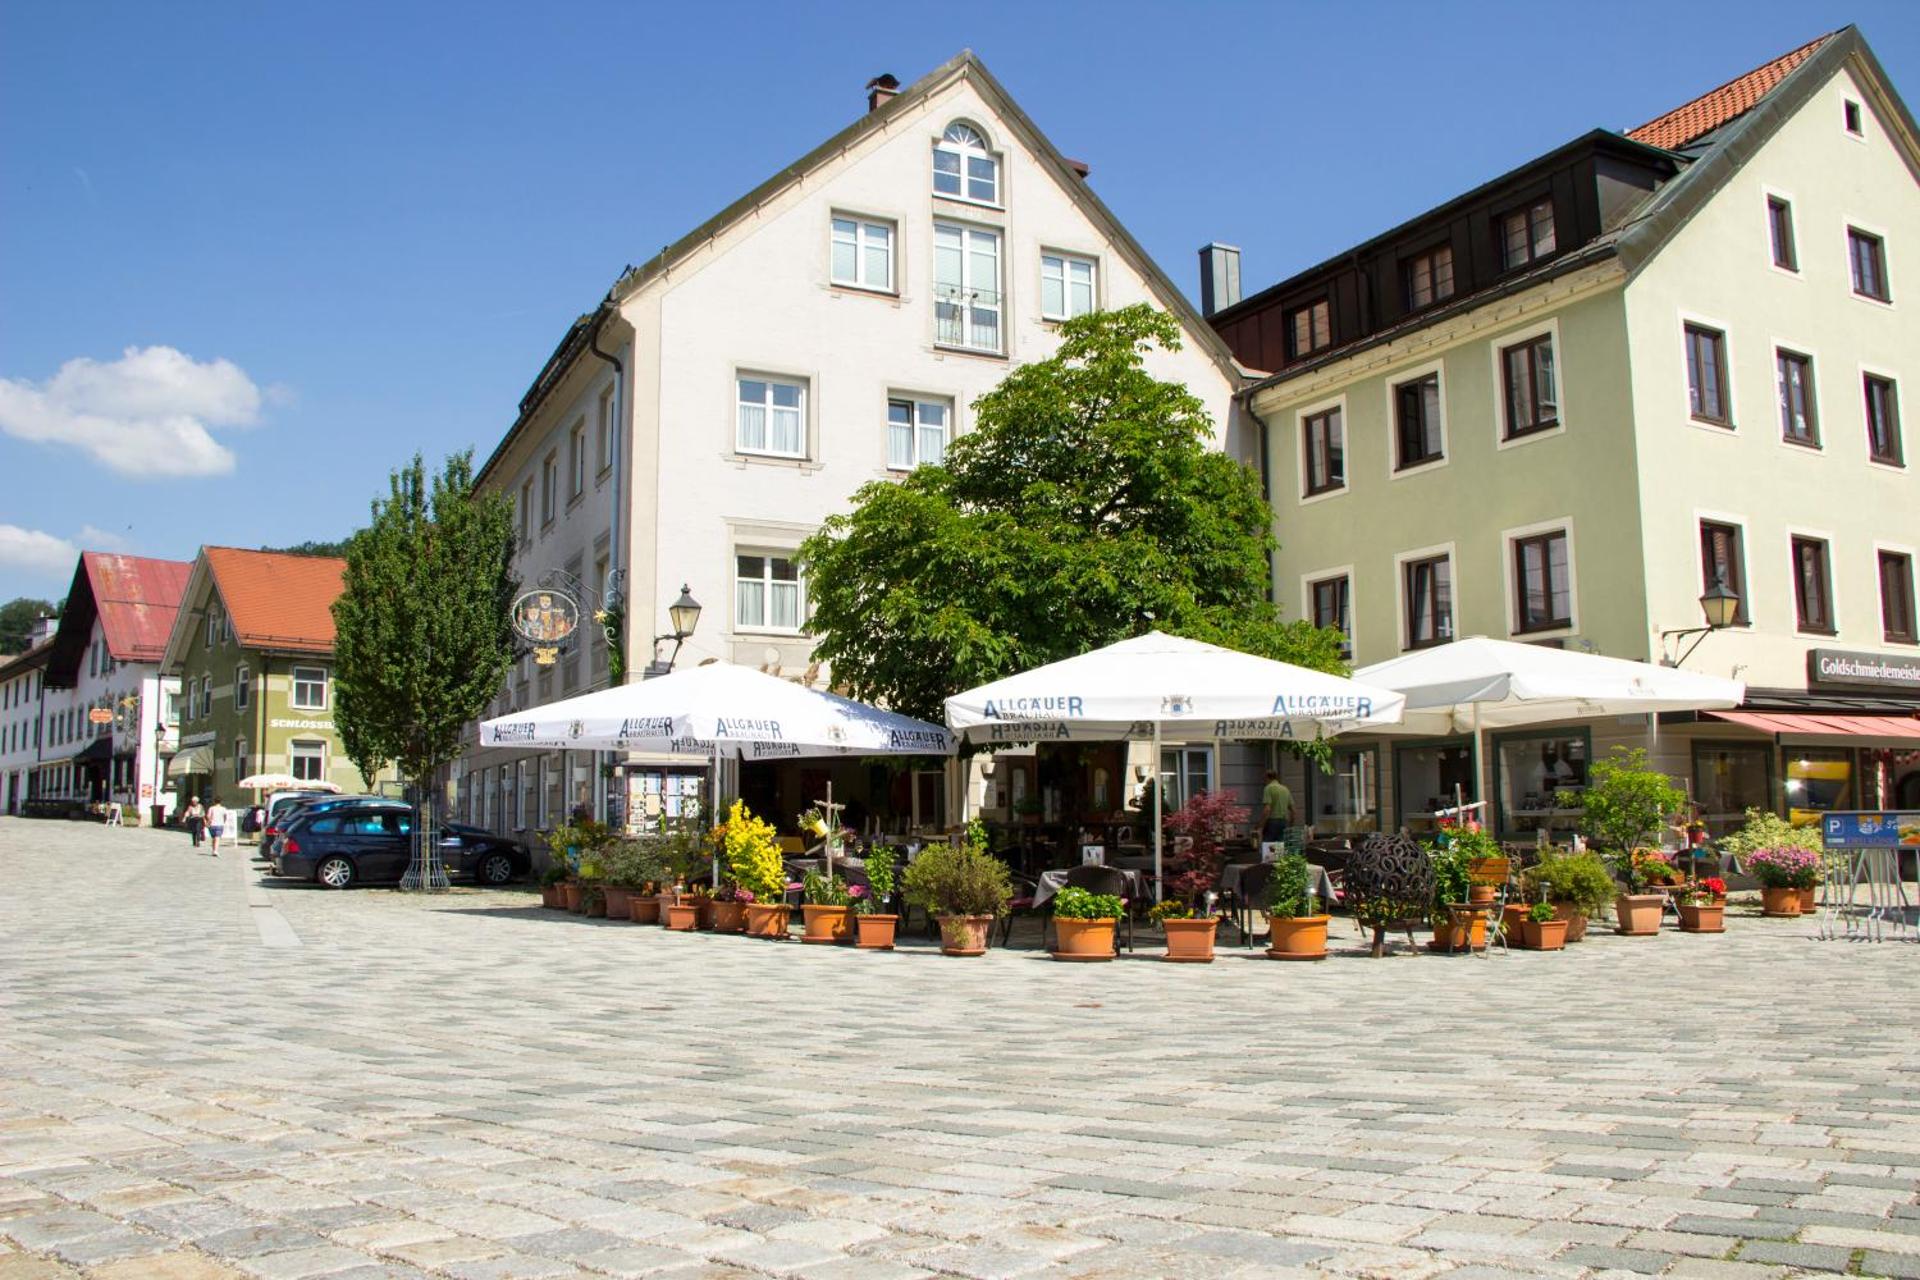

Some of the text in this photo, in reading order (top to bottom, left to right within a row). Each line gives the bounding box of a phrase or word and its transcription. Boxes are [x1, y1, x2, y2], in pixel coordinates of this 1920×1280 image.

[984, 696, 1084, 720] ALLGÄUER
[1272, 695, 1373, 719] ALLGÄUER
[1829, 820, 1841, 833] P
